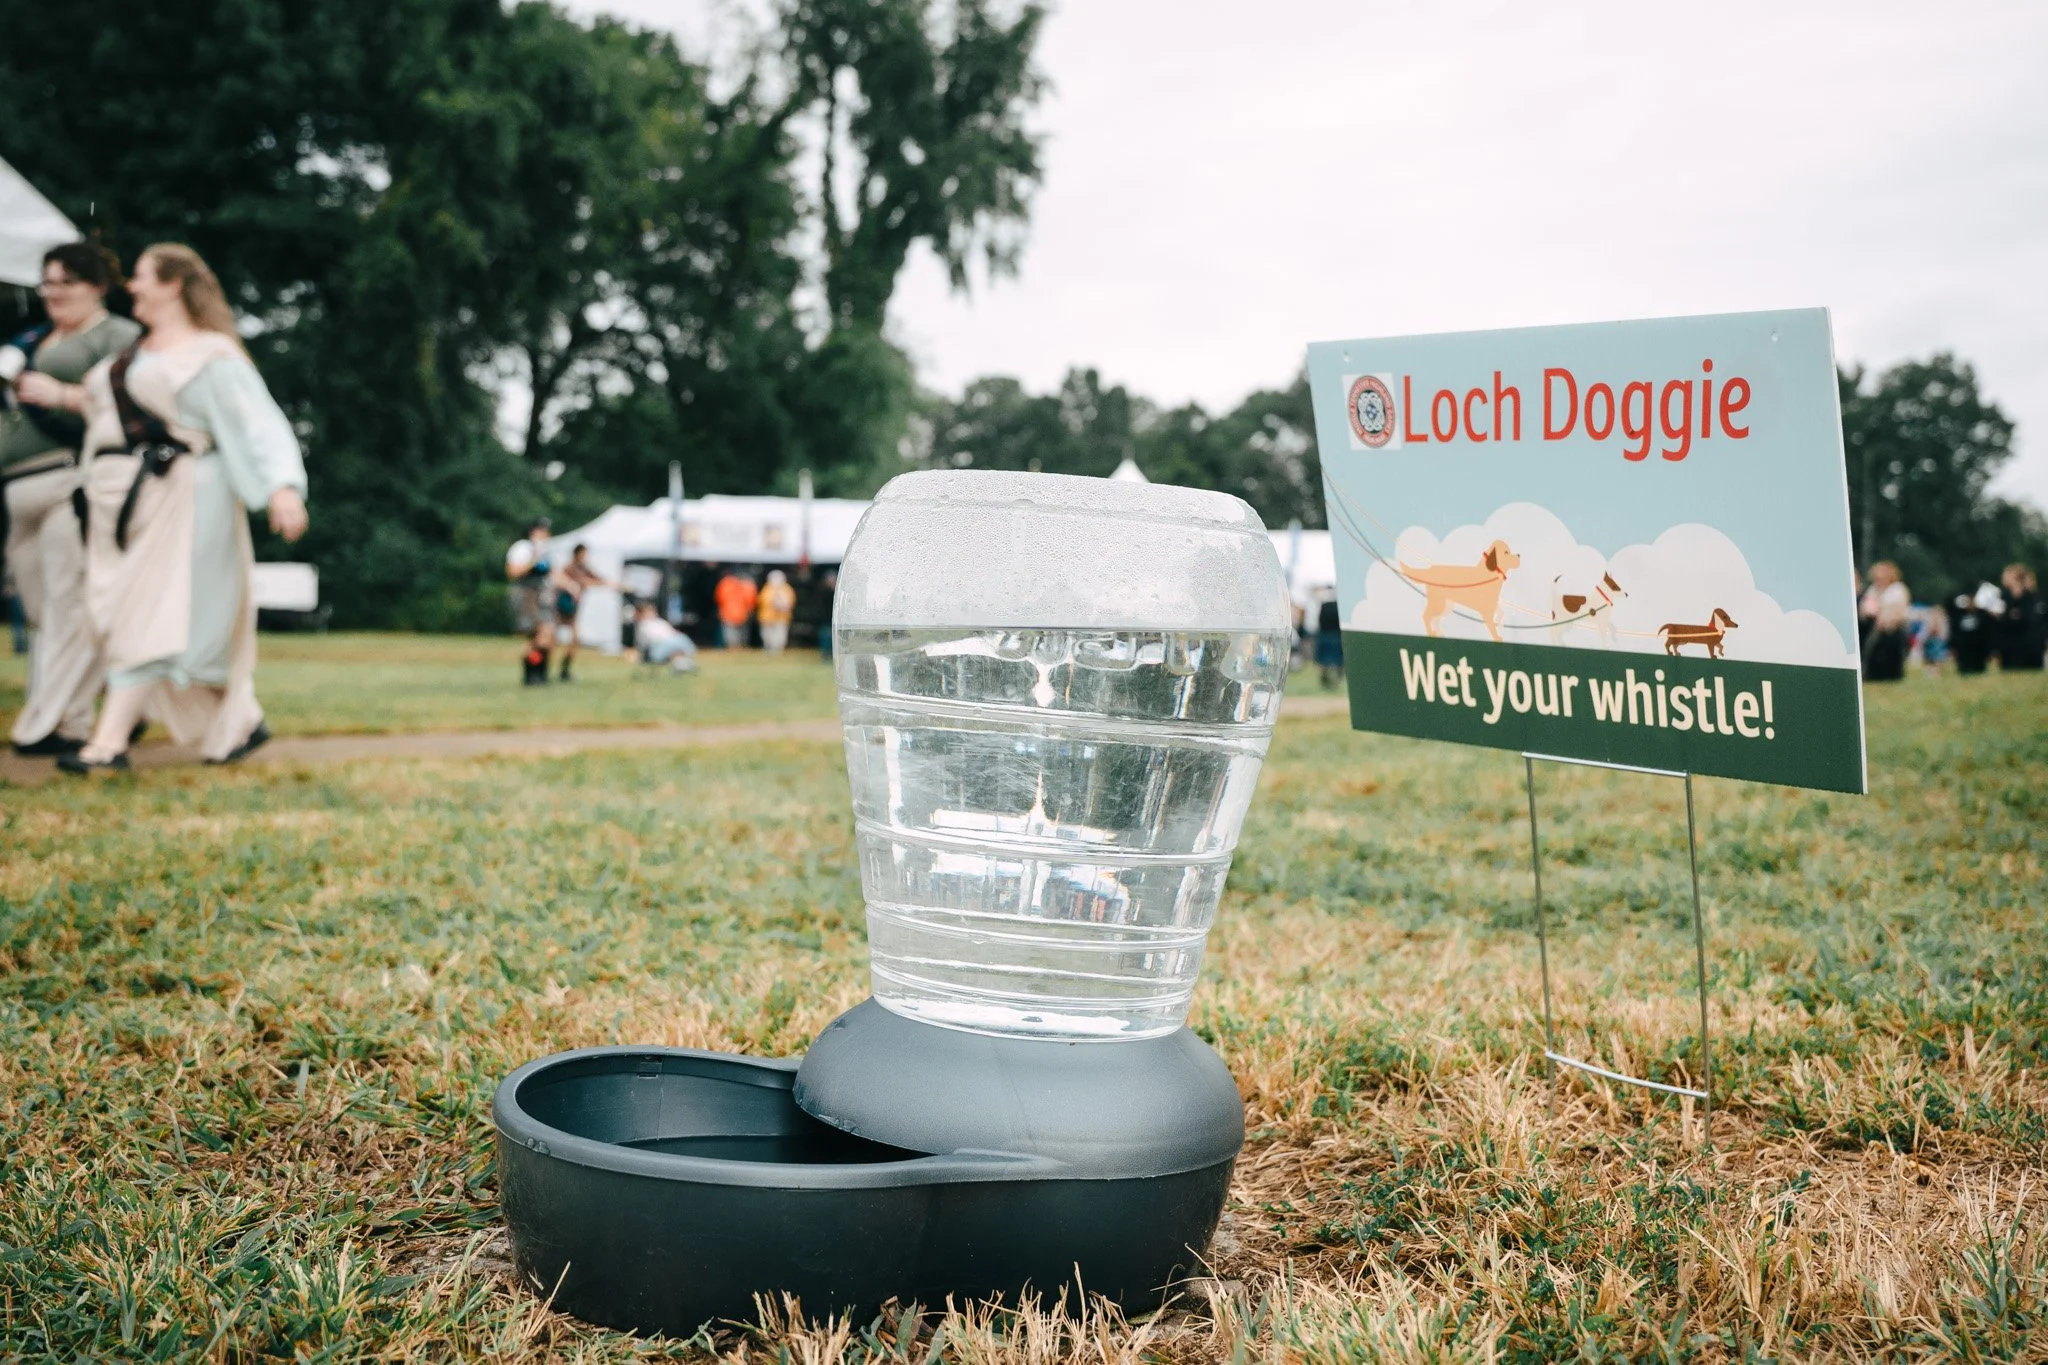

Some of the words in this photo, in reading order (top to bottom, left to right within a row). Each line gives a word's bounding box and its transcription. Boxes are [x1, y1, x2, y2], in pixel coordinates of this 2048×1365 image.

[1403, 370, 1522, 444] Loch
[1542, 358, 1752, 462] Doggie
[1399, 648, 1477, 708] Wet
[1482, 667, 1580, 725] your
[1588, 668, 1776, 741] whistle!
